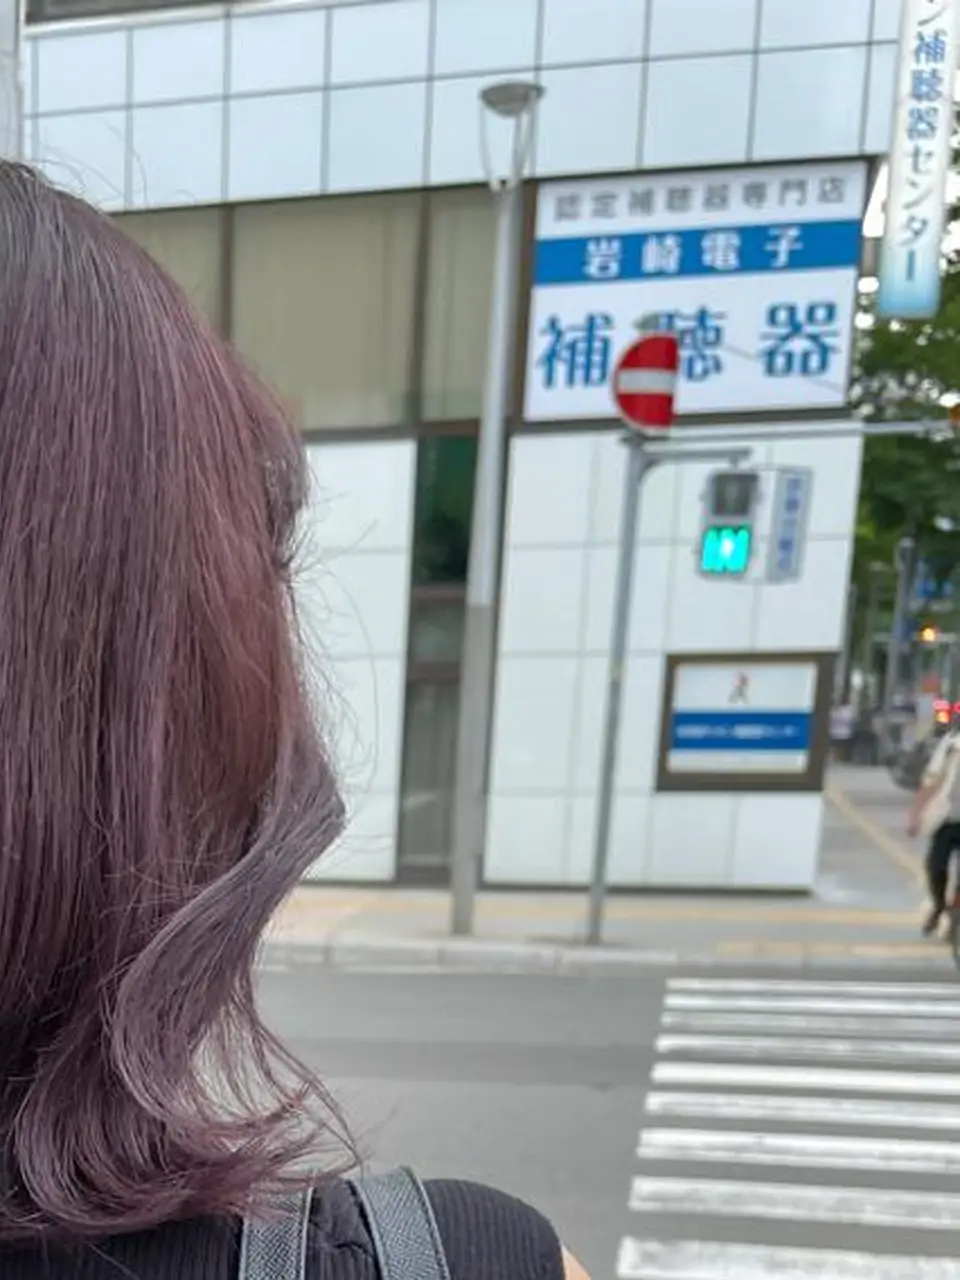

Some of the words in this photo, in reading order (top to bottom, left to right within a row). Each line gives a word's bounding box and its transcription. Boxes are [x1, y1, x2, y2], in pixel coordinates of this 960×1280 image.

[553, 177, 845, 222] 認定補聴器専門店
[583, 226, 803, 280] 岩崎電子
[536, 301, 842, 390] 補聴器
